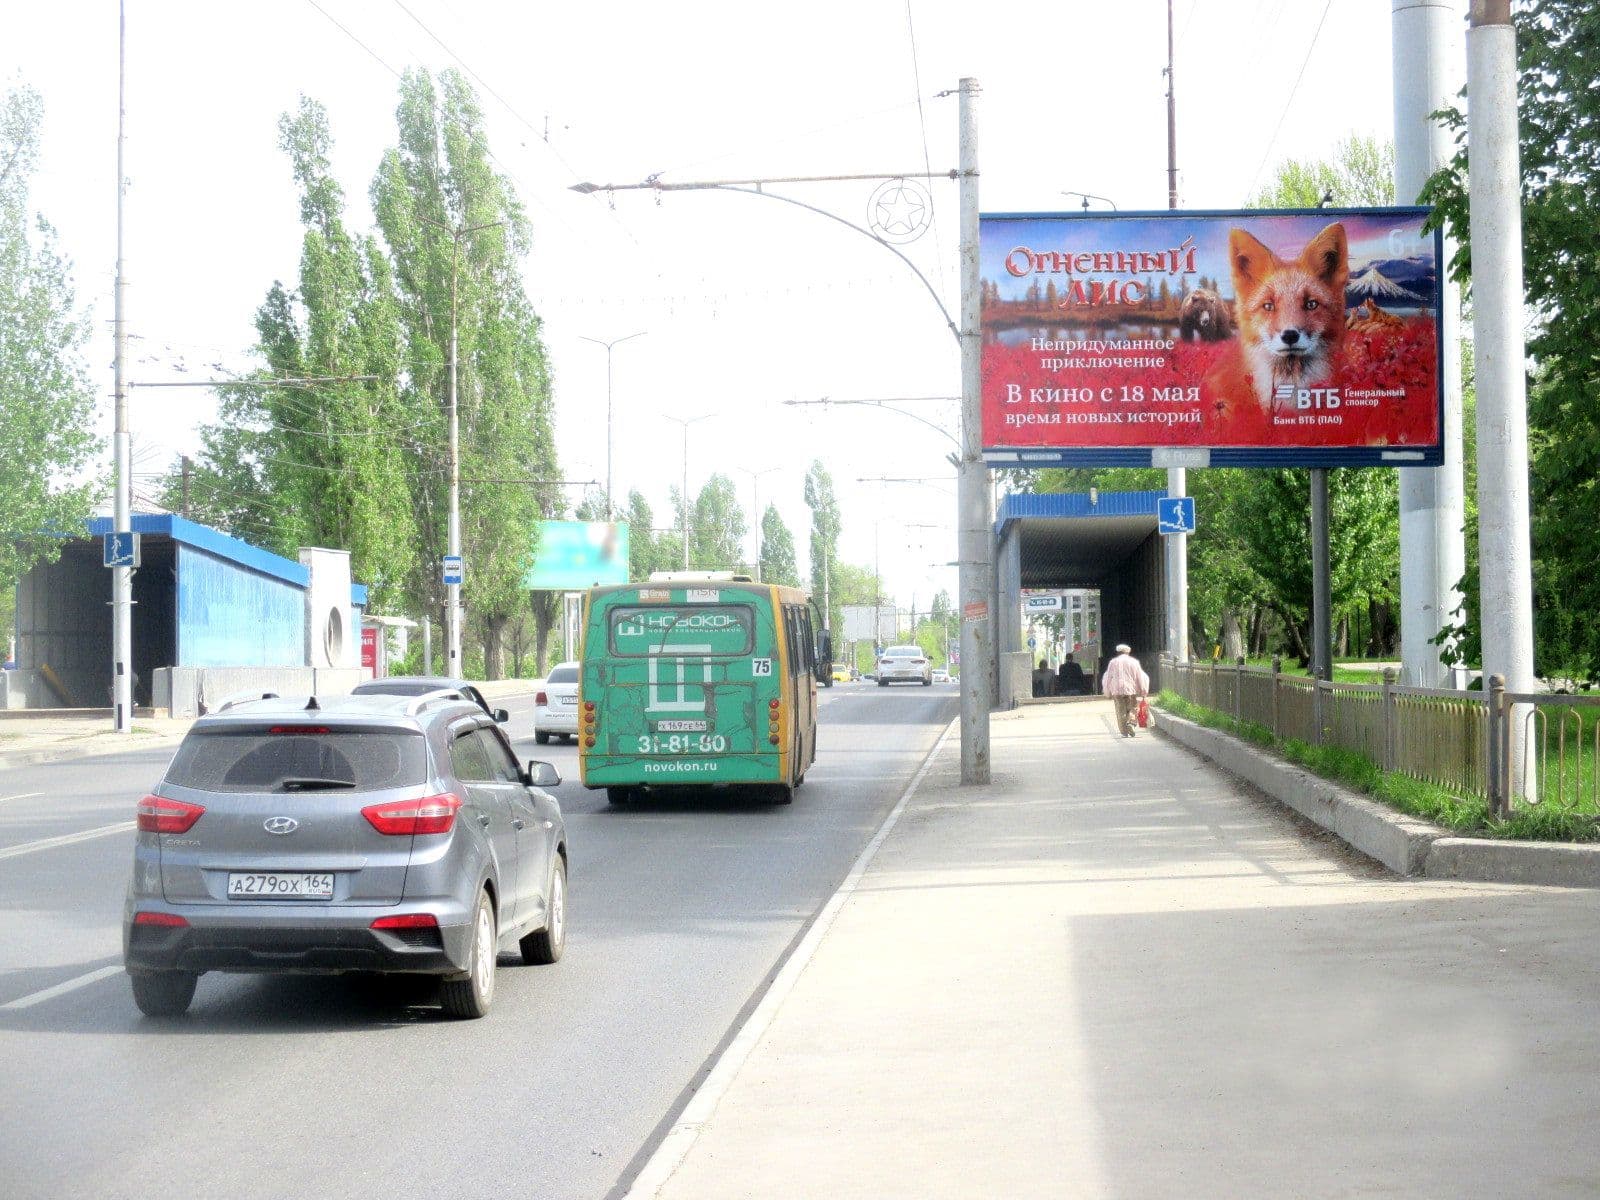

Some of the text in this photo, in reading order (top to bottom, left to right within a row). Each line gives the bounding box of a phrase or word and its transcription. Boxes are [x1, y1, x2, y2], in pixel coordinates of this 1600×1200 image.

[1005, 236, 1197, 276] Огненный
[1031, 338, 1174, 354] Непридуманное
[1041, 356, 1165, 372] приключение
[1006, 384, 1201, 404] В кино с 18 мая
[1297, 388, 1341, 409] ВТБ
[1344, 387, 1405, 399] Генеральный
[1345, 398, 1379, 407] спонсор
[1005, 409, 1201, 427] время новых историй
[1273, 415, 1343, 426] Банк ВТБ (ПАО)
[754, 660, 770, 674] 75
[644, 760, 718, 773] novokon.ru
[304, 875, 331, 888] 164
